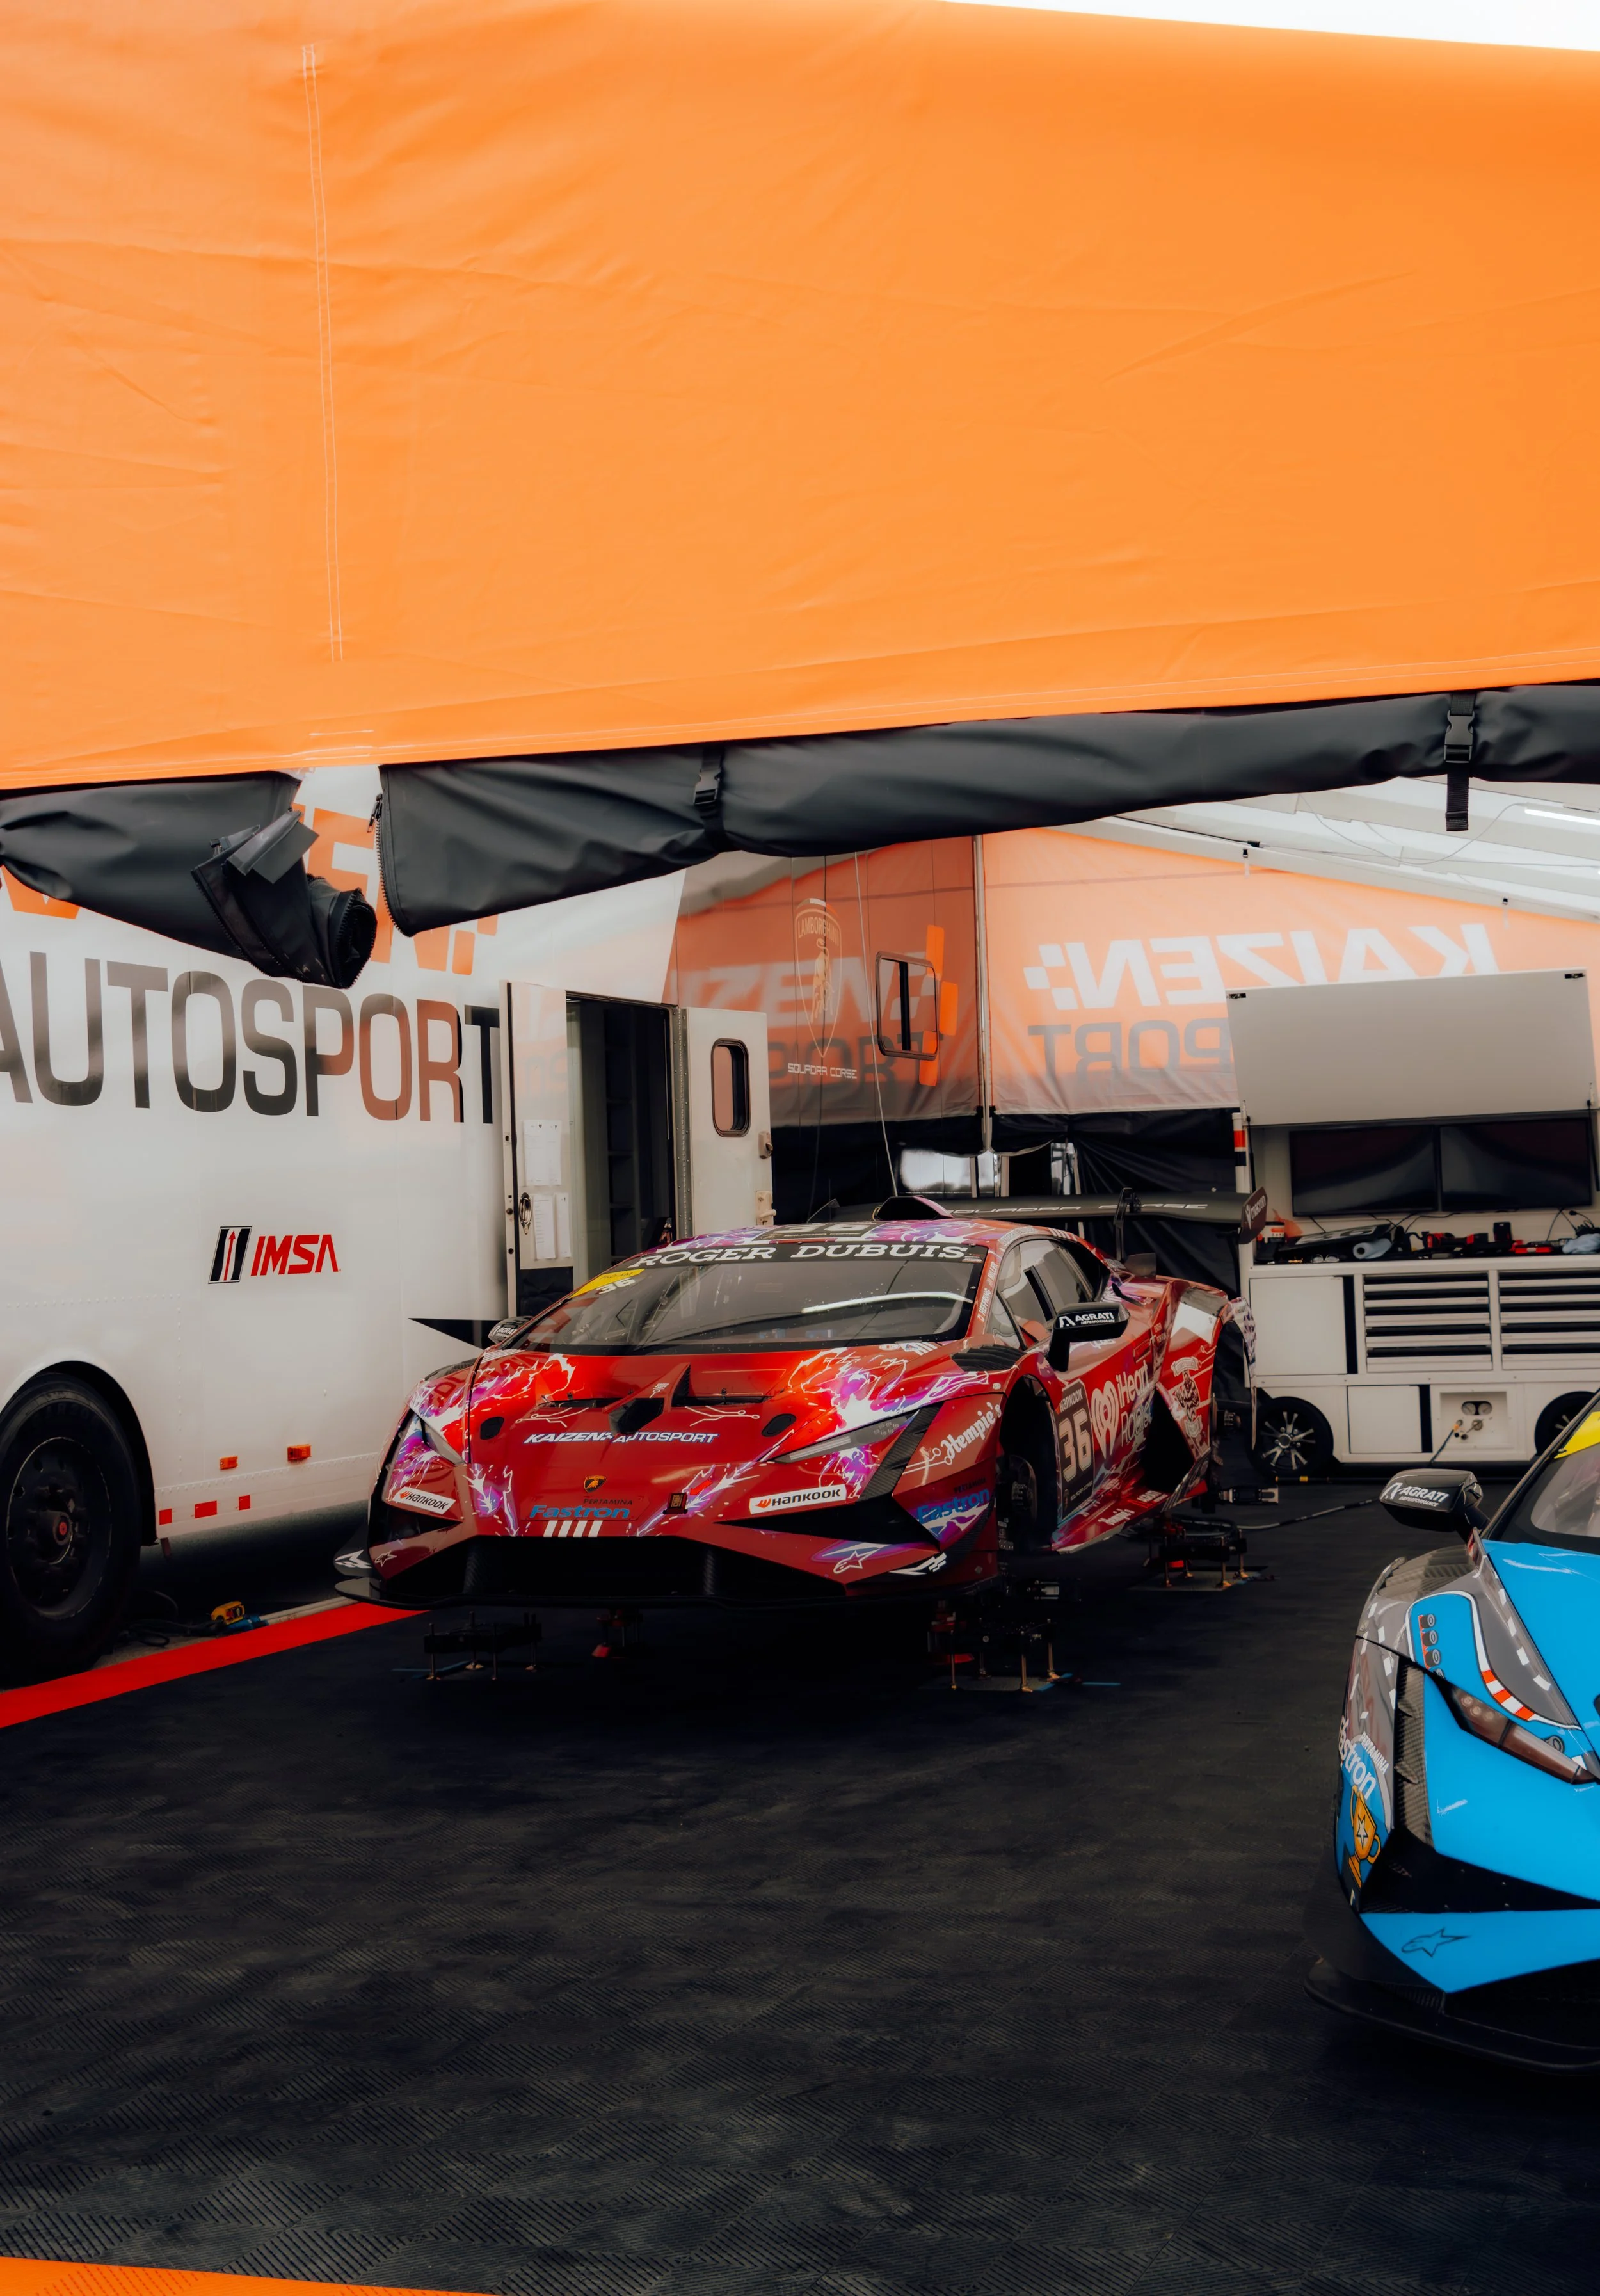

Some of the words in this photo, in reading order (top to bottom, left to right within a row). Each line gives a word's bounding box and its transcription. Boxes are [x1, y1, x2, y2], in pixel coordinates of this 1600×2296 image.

[798, 916, 839, 946] LAMBORGHINI
[788, 1063, 828, 1077] SQUADRA
[830, 1067, 858, 1079] CORSE
[1251, 1194, 1267, 1217] macron
[250, 1234, 339, 1276] IMSA
[627, 1246, 777, 1269] ROGER
[790, 1244, 968, 1260] DUBUIS
[595, 1276, 636, 1295] 36
[1075, 1312, 1114, 1322] AGRATI
[1116, 1360, 1149, 1409] iHeart
[524, 1431, 606, 1444] KAIZEN
[613, 1431, 719, 1444] AUTOSPORT
[941, 1402, 1002, 1459] Hempie's
[1059, 1408, 1094, 1482] 36
[917, 1488, 990, 1523] Fastron
[1398, 1486, 1450, 1502] AGRATI
[529, 1505, 630, 1519] Fastron
[1361, 1731, 1389, 1775] PERTAMINA
